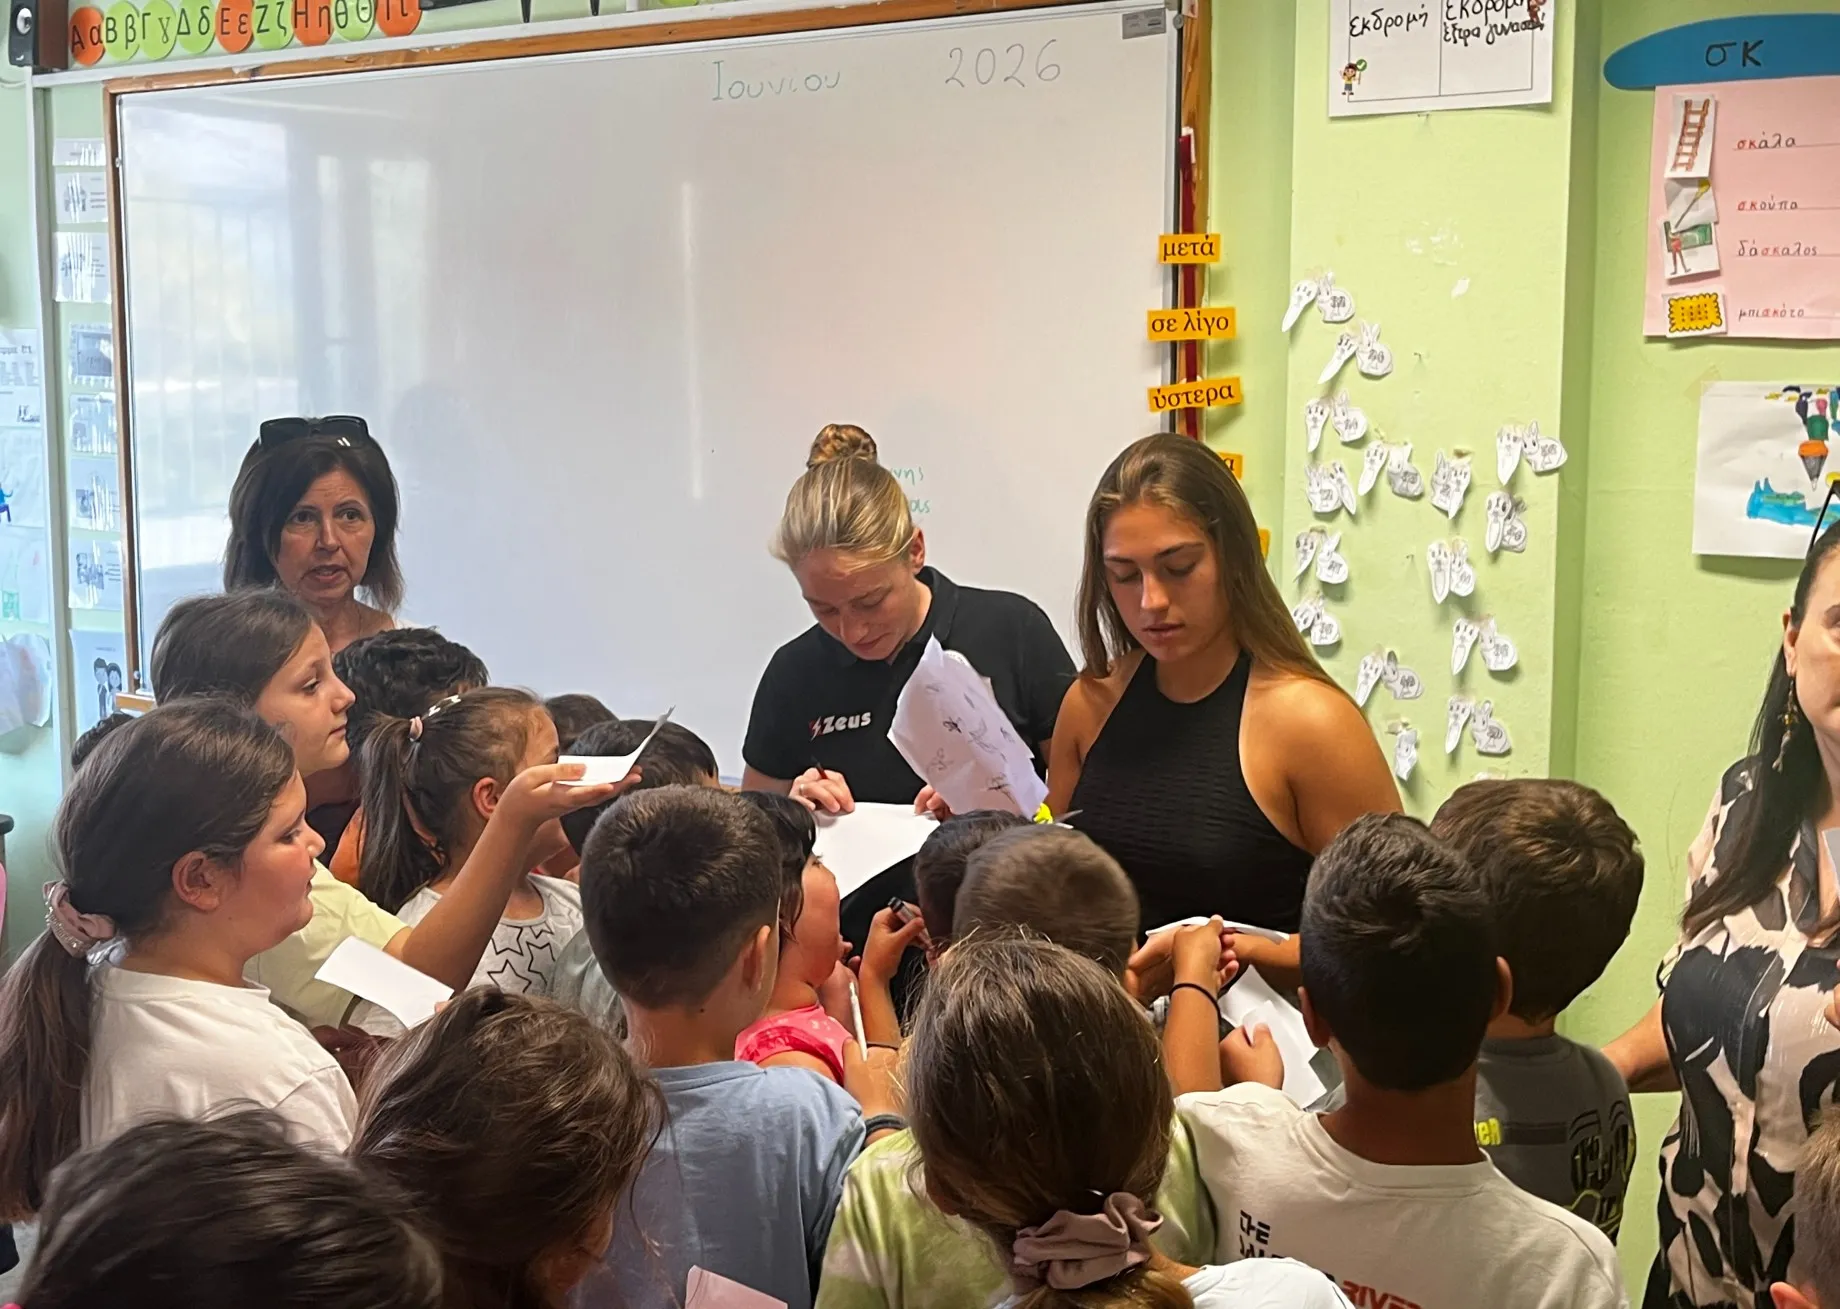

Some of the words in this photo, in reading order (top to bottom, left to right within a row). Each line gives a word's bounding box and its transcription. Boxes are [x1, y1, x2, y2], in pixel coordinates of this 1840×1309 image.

[945, 39, 1061, 88] 2026
[1736, 130, 1797, 150] σκάλα
[1737, 194, 1799, 212] σκούπα
[1163, 234, 1215, 262] μετά
[1738, 239, 1818, 257] δάσκαλος
[1151, 317, 1178, 333] σε
[1183, 310, 1229, 337] λίγο
[1738, 303, 1805, 322] μπισκότο
[1153, 387, 1235, 410] ύστερα
[822, 711, 872, 735] Zeus
